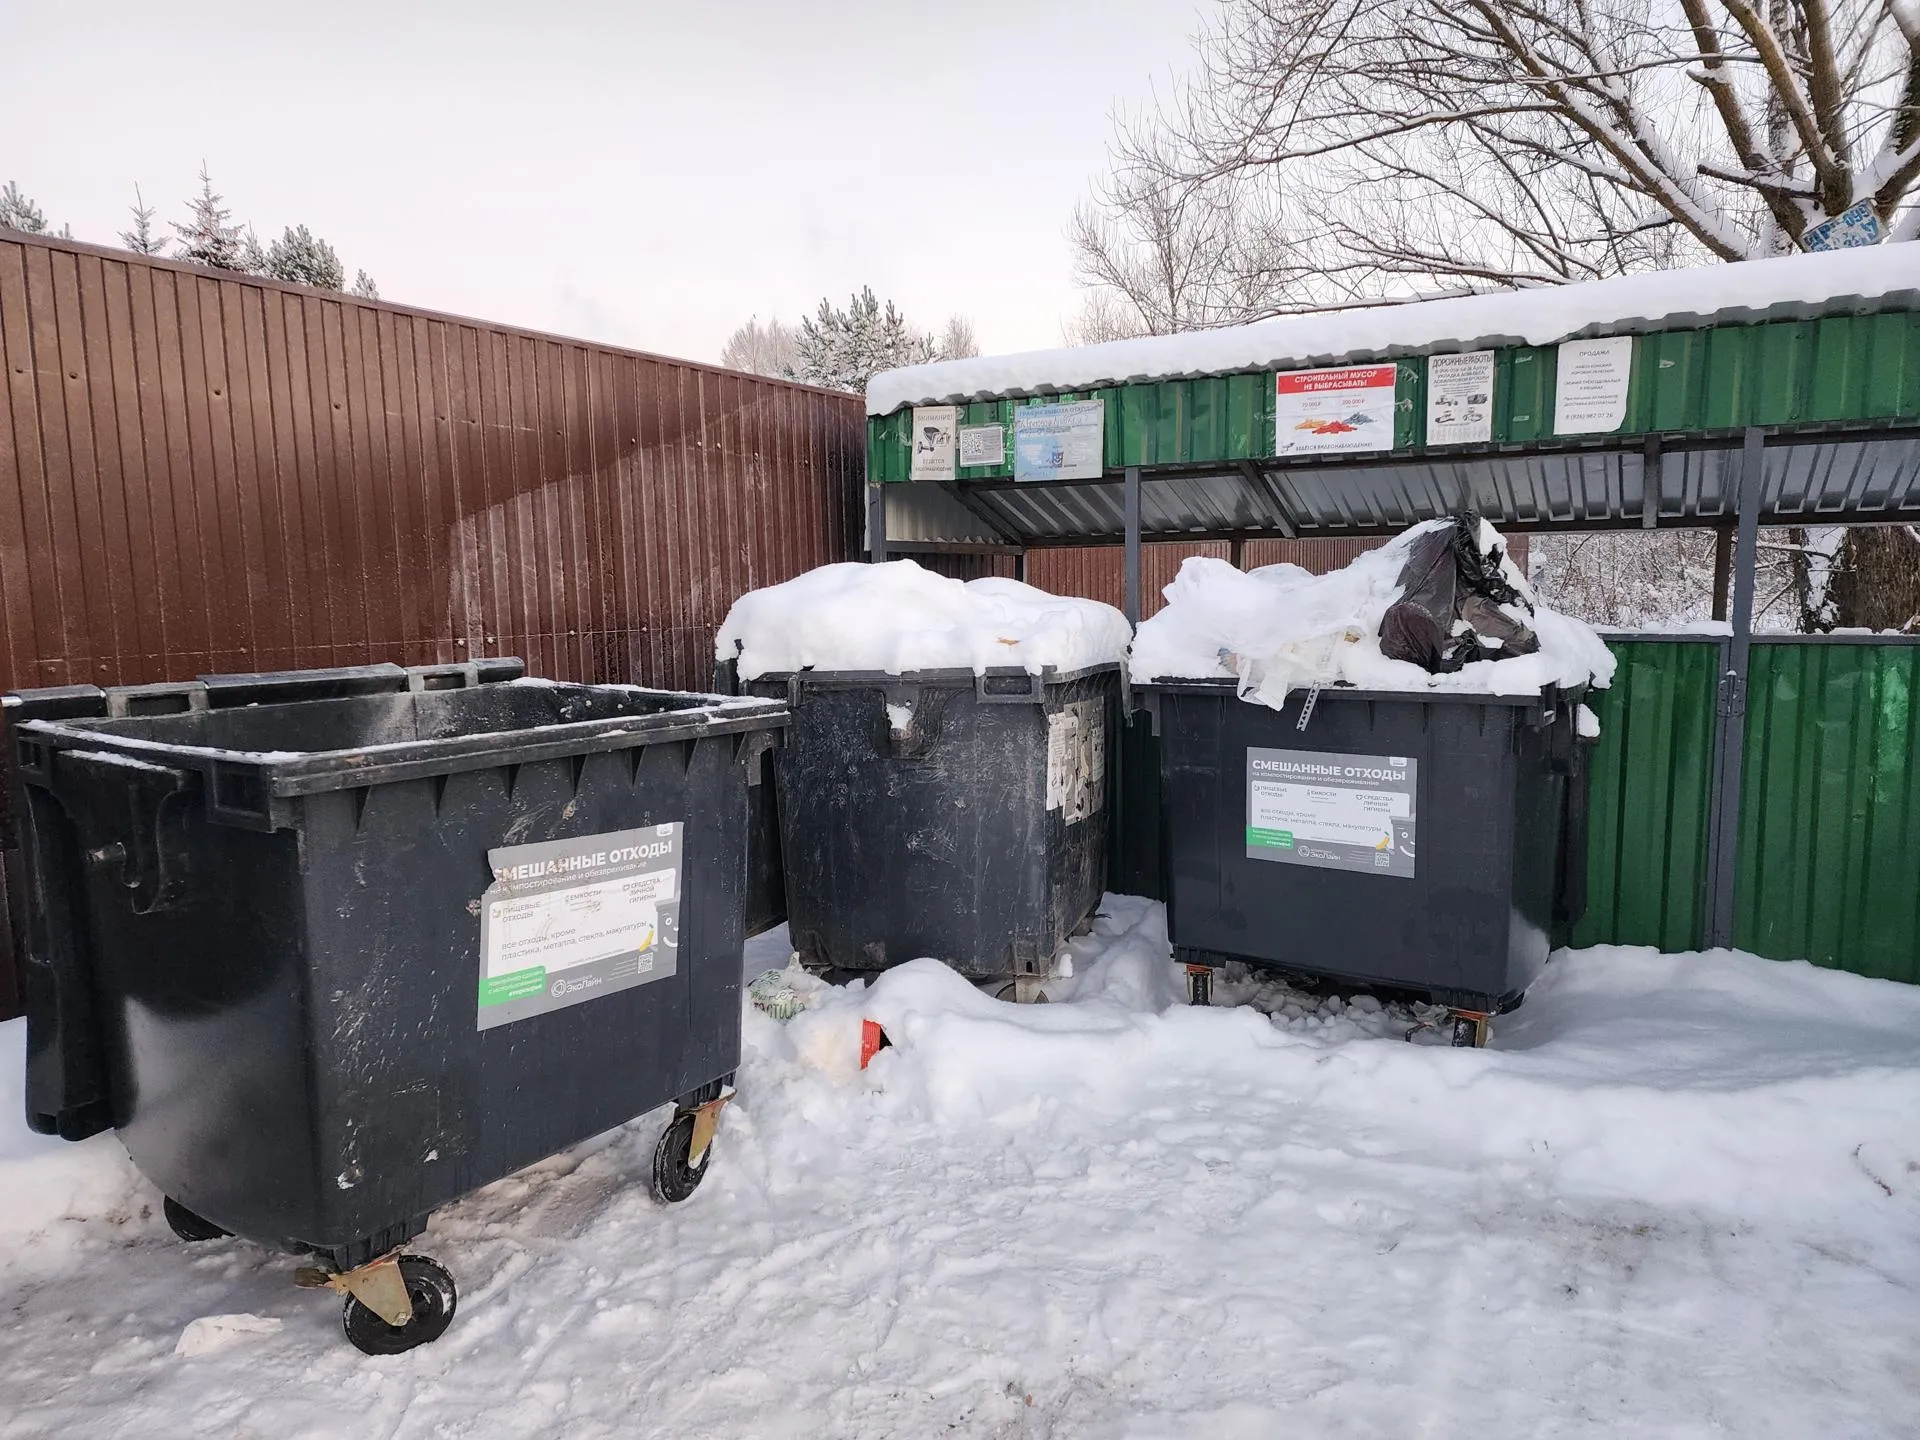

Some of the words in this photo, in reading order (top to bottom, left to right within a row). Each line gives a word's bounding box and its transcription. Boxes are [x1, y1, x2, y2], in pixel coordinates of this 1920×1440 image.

[1295, 371, 1349, 383] СТРОИТЕЛЬНЫЙ
[1350, 370, 1377, 379] МУСОР
[1314, 380, 1367, 389] ВЫБРАСЫВАТЬ!
[1252, 760, 1342, 776] СМЕШАННЫЕ
[1344, 767, 1406, 782] ОТХОДЫ
[609, 840, 672, 864] ОТХОДЫ
[569, 889, 602, 901] ЕМКОСТИ
[503, 901, 542, 913] ПИЩЕВЫЕ
[502, 911, 534, 923] ОТХОДЫ
[501, 942, 518, 950] все
[551, 928, 577, 939] кроме
[501, 947, 542, 960] пластика,
[543, 938, 577, 951] металла,
[578, 932, 605, 943] стекла,
[605, 921, 647, 936] макулатуры
[566, 977, 602, 993] ЭкоЛайн
